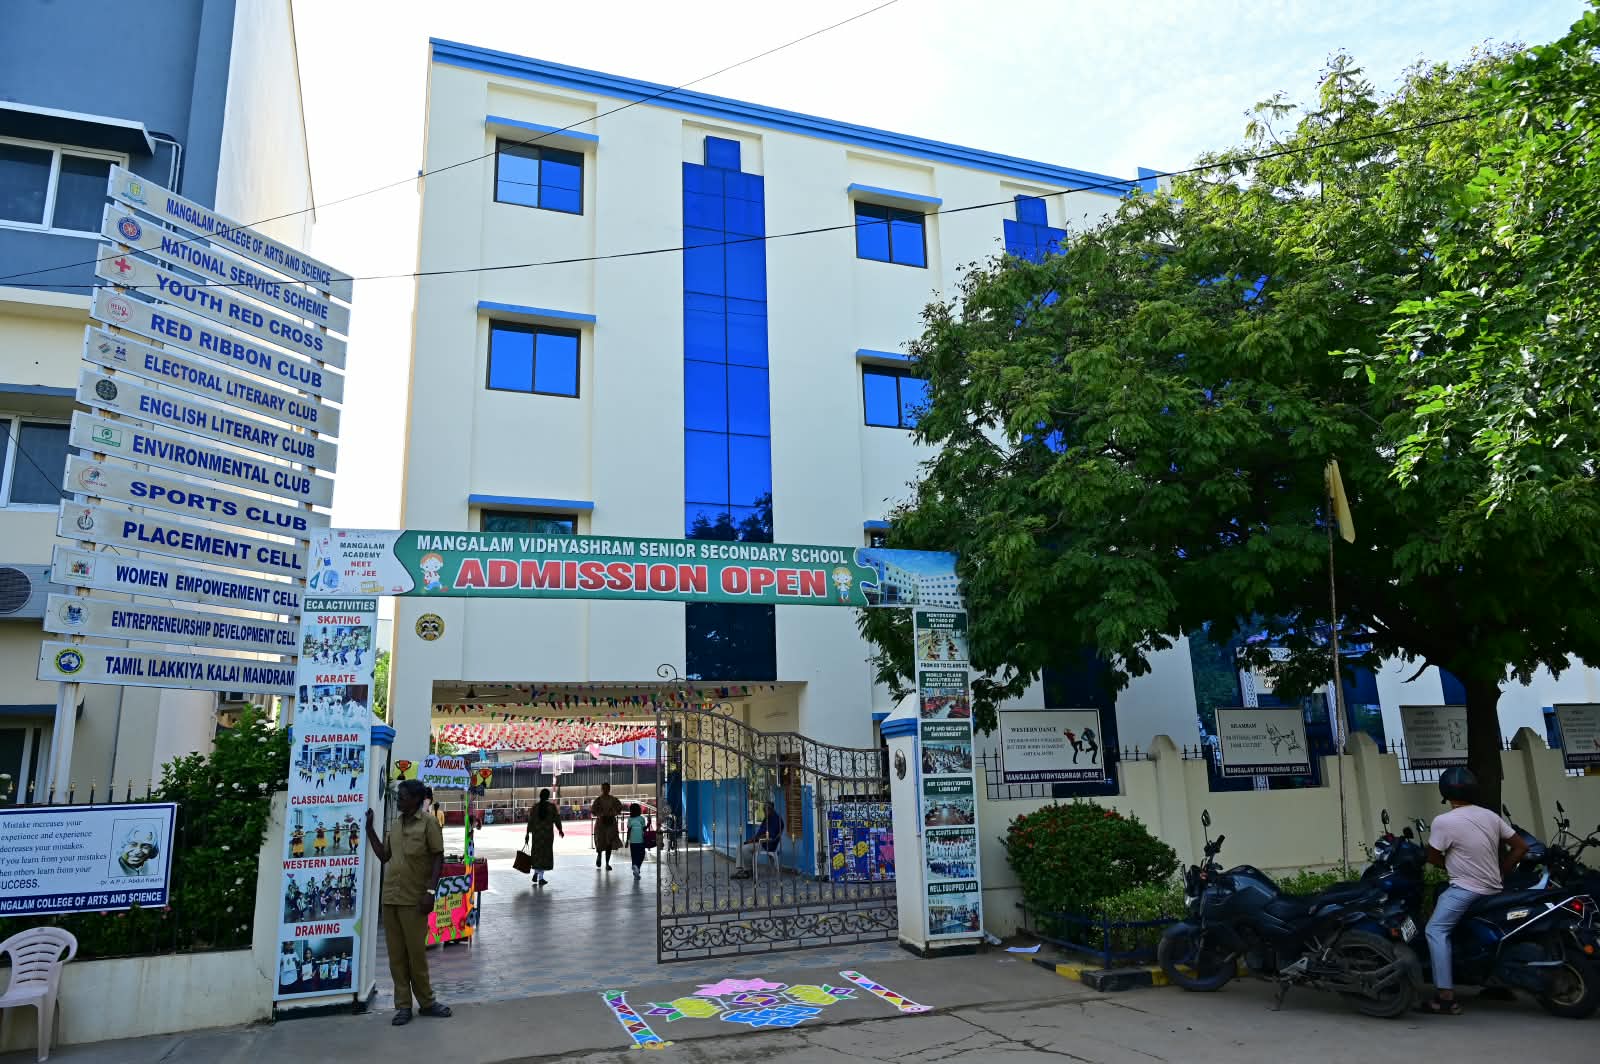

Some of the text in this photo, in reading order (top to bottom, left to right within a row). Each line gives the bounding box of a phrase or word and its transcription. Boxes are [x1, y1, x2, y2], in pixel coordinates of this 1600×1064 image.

[166, 198, 214, 232] MANGALAM
[215, 221, 251, 250] COLLEGE
[252, 239, 264, 254] OF
[264, 243, 283, 263] ARTS
[284, 253, 300, 270] AND
[300, 259, 331, 286] SCIENCE
[161, 235, 328, 319] NATIONAL SERVICE SCHEME
[156, 274, 222, 313] YOUTH
[229, 303, 264, 328] RED
[269, 320, 324, 351] CROSS
[150, 313, 193, 341] RED
[200, 330, 272, 370] RIBBON
[277, 361, 323, 388] CLUB
[144, 354, 318, 423] ELECTORAL LITERARY CLUB
[139, 395, 315, 459] ENGLISH LITERARY CLUB
[133, 435, 311, 495] ENVIRONMENTAL CLUB
[130, 481, 307, 531] SPORTS CLUB
[123, 521, 302, 570] PLACEMENT CELL
[417, 535, 848, 564] MANGALAM VIDHYASHRAM SENIOR SECONDARY SCHOOL
[116, 565, 299, 608] WOMEN EMPOWERMENT CELL
[454, 558, 827, 598] ADMISSION OPEN
[306, 601, 375, 610] ECA ACTIVITIES
[317, 615, 361, 625] SKATING
[111, 610, 296, 646] ENTREPRENEURSHIP DEVELOPMENT CELL
[105, 655, 144, 676] TAMIL
[148, 660, 203, 680] ILAKKIYA
[207, 664, 240, 683] KALAI
[243, 667, 295, 686] MANDRAM
[315, 674, 356, 683] KARATE
[304, 734, 359, 743] SILAMBAM
[423, 774, 470, 785] SPORTS MEET
[291, 793, 364, 805] CLASSICAL DANCE
[1, 831, 93, 841] experience and experience
[3, 820, 30, 829] Mistake
[6, 858, 20, 866] you
[21, 856, 39, 864] learn
[77, 853, 107, 861] mistakes
[13, 868, 35, 877] others
[37, 867, 55, 875] learn
[56, 866, 74, 874] from
[75, 866, 92, 874] your
[283, 856, 359, 870] WESTERN DANCE
[37, 897, 74, 909] COLLEGE
[74, 896, 87, 906] OF
[87, 895, 108, 905] ARTS
[110, 893, 127, 904] AND
[128, 891, 162, 903] SCIENCE
[295, 923, 340, 937] DRAWING
